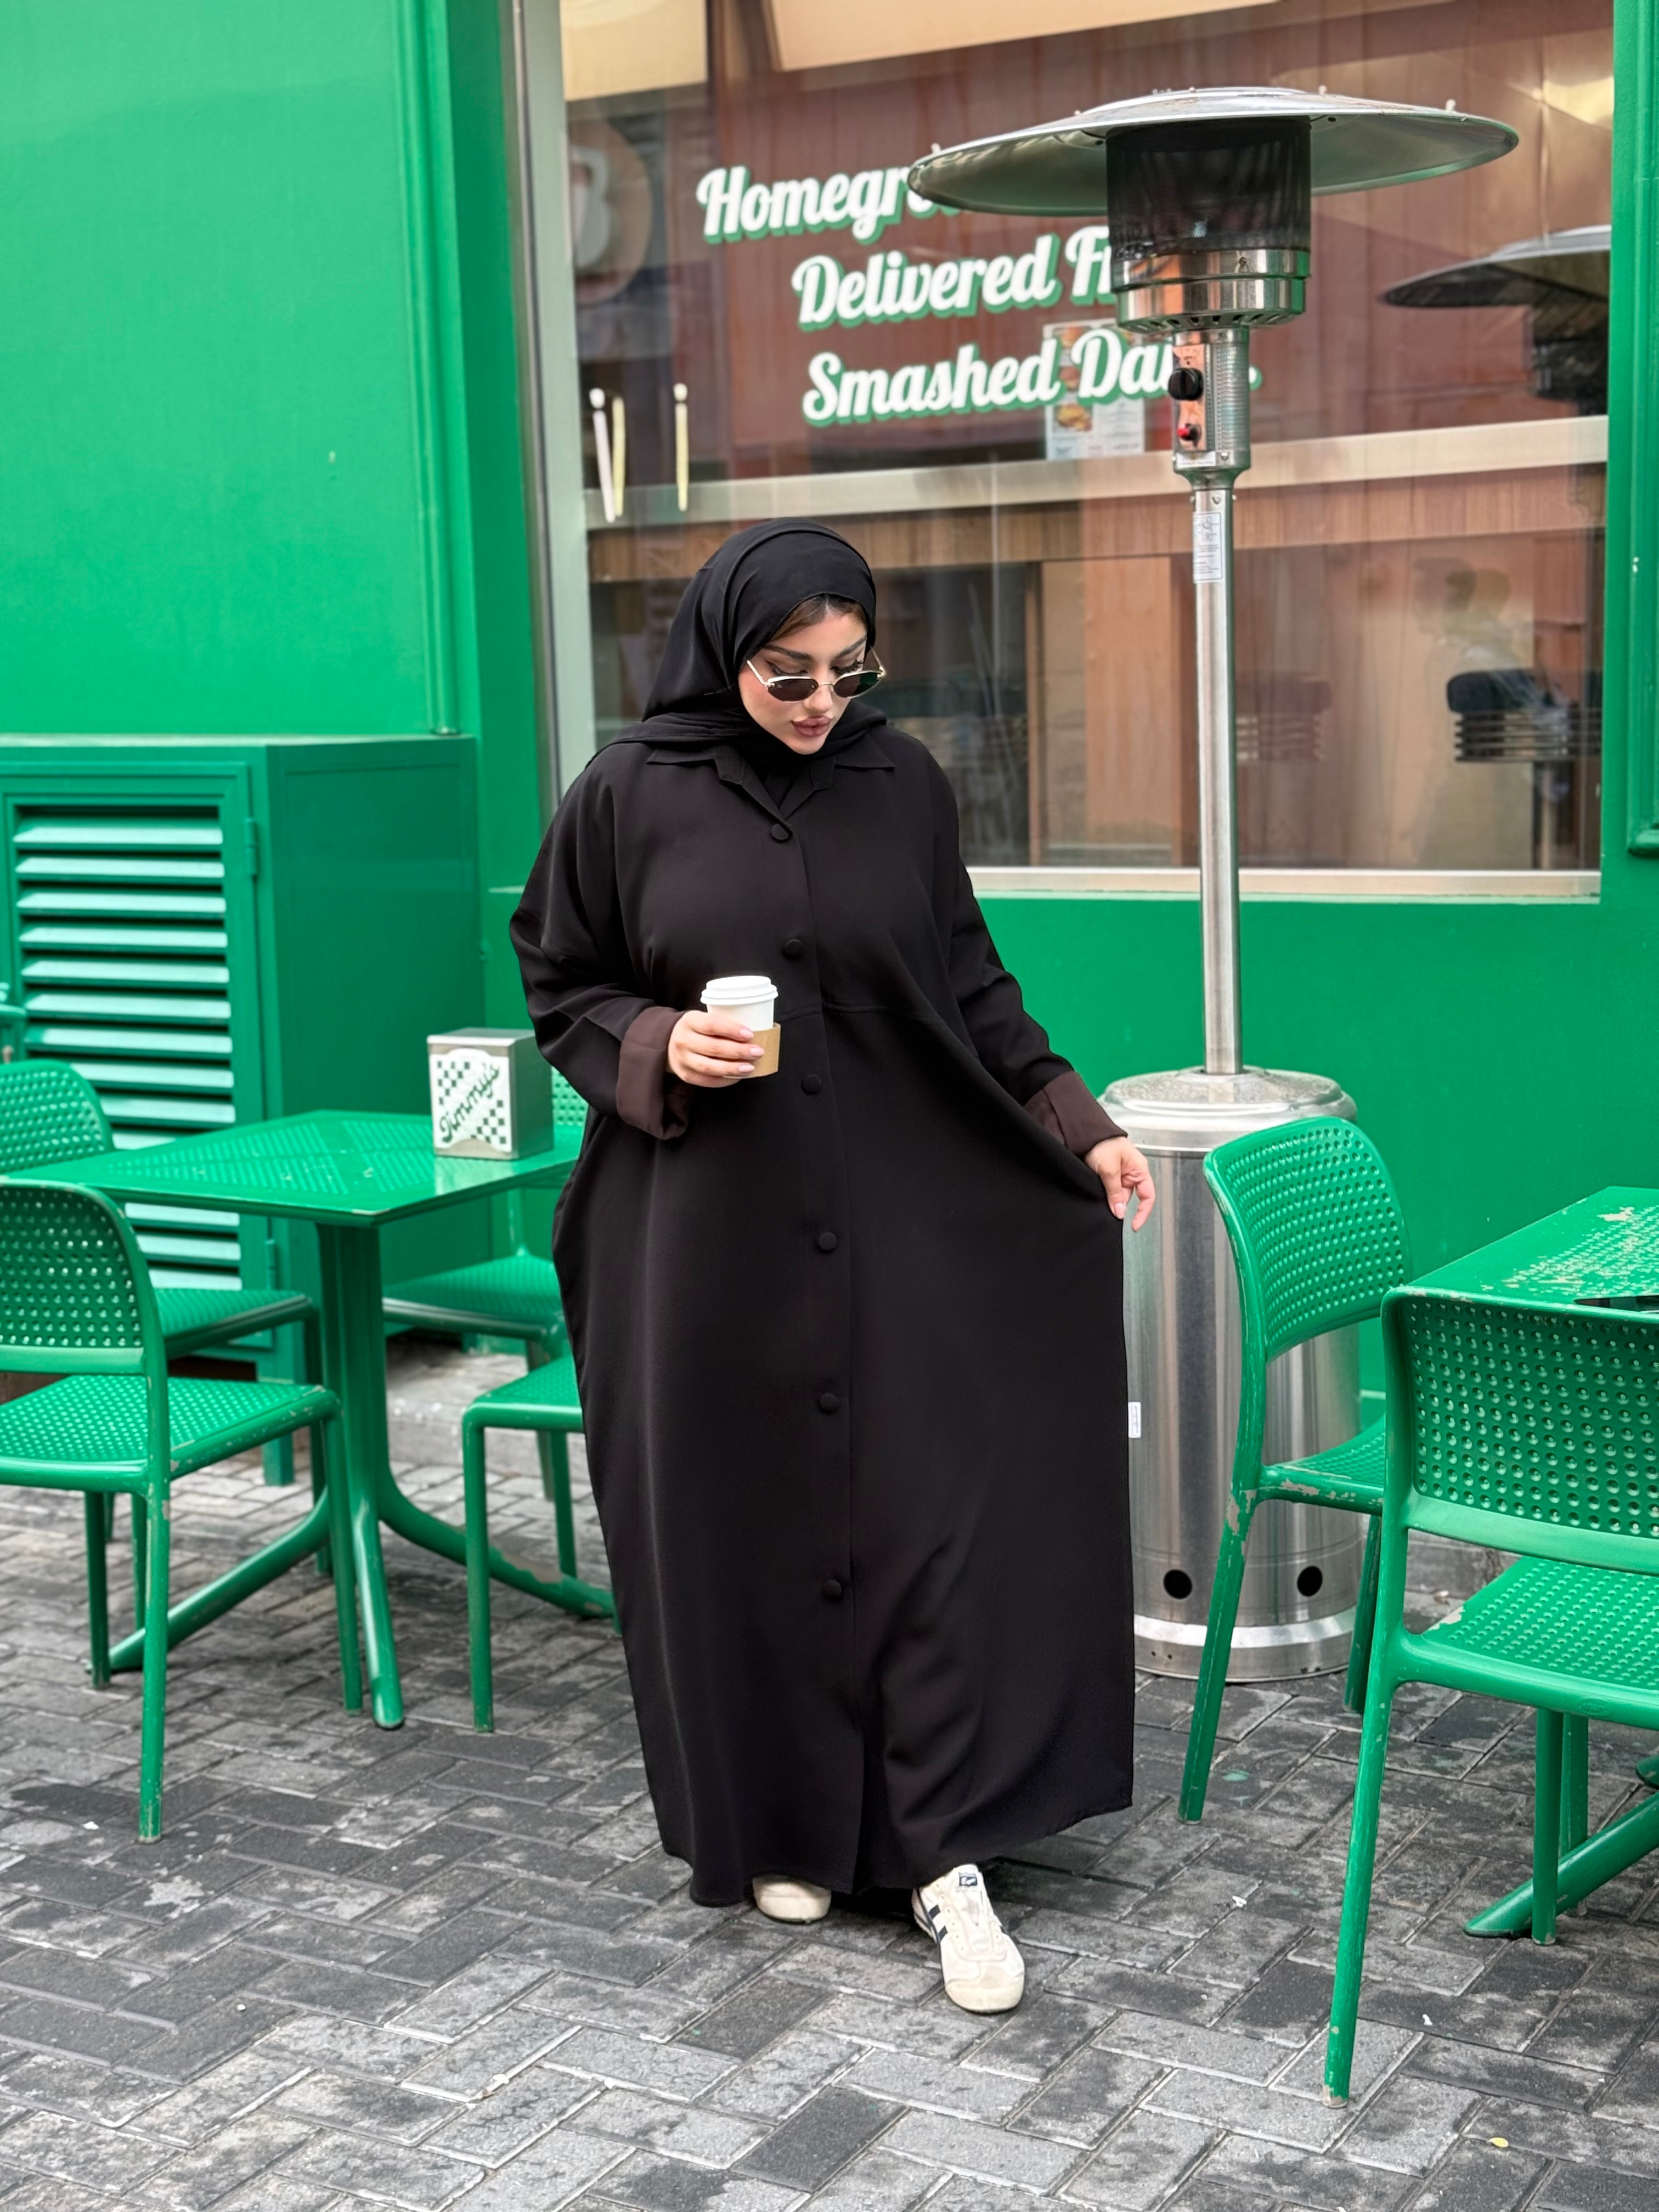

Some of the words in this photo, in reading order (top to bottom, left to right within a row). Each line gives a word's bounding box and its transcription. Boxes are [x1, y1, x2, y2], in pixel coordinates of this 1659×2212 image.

[791, 234, 1061, 330] Delivered
[802, 337, 1065, 426] Smashed
[438, 1062, 500, 1143] Jimmy's
